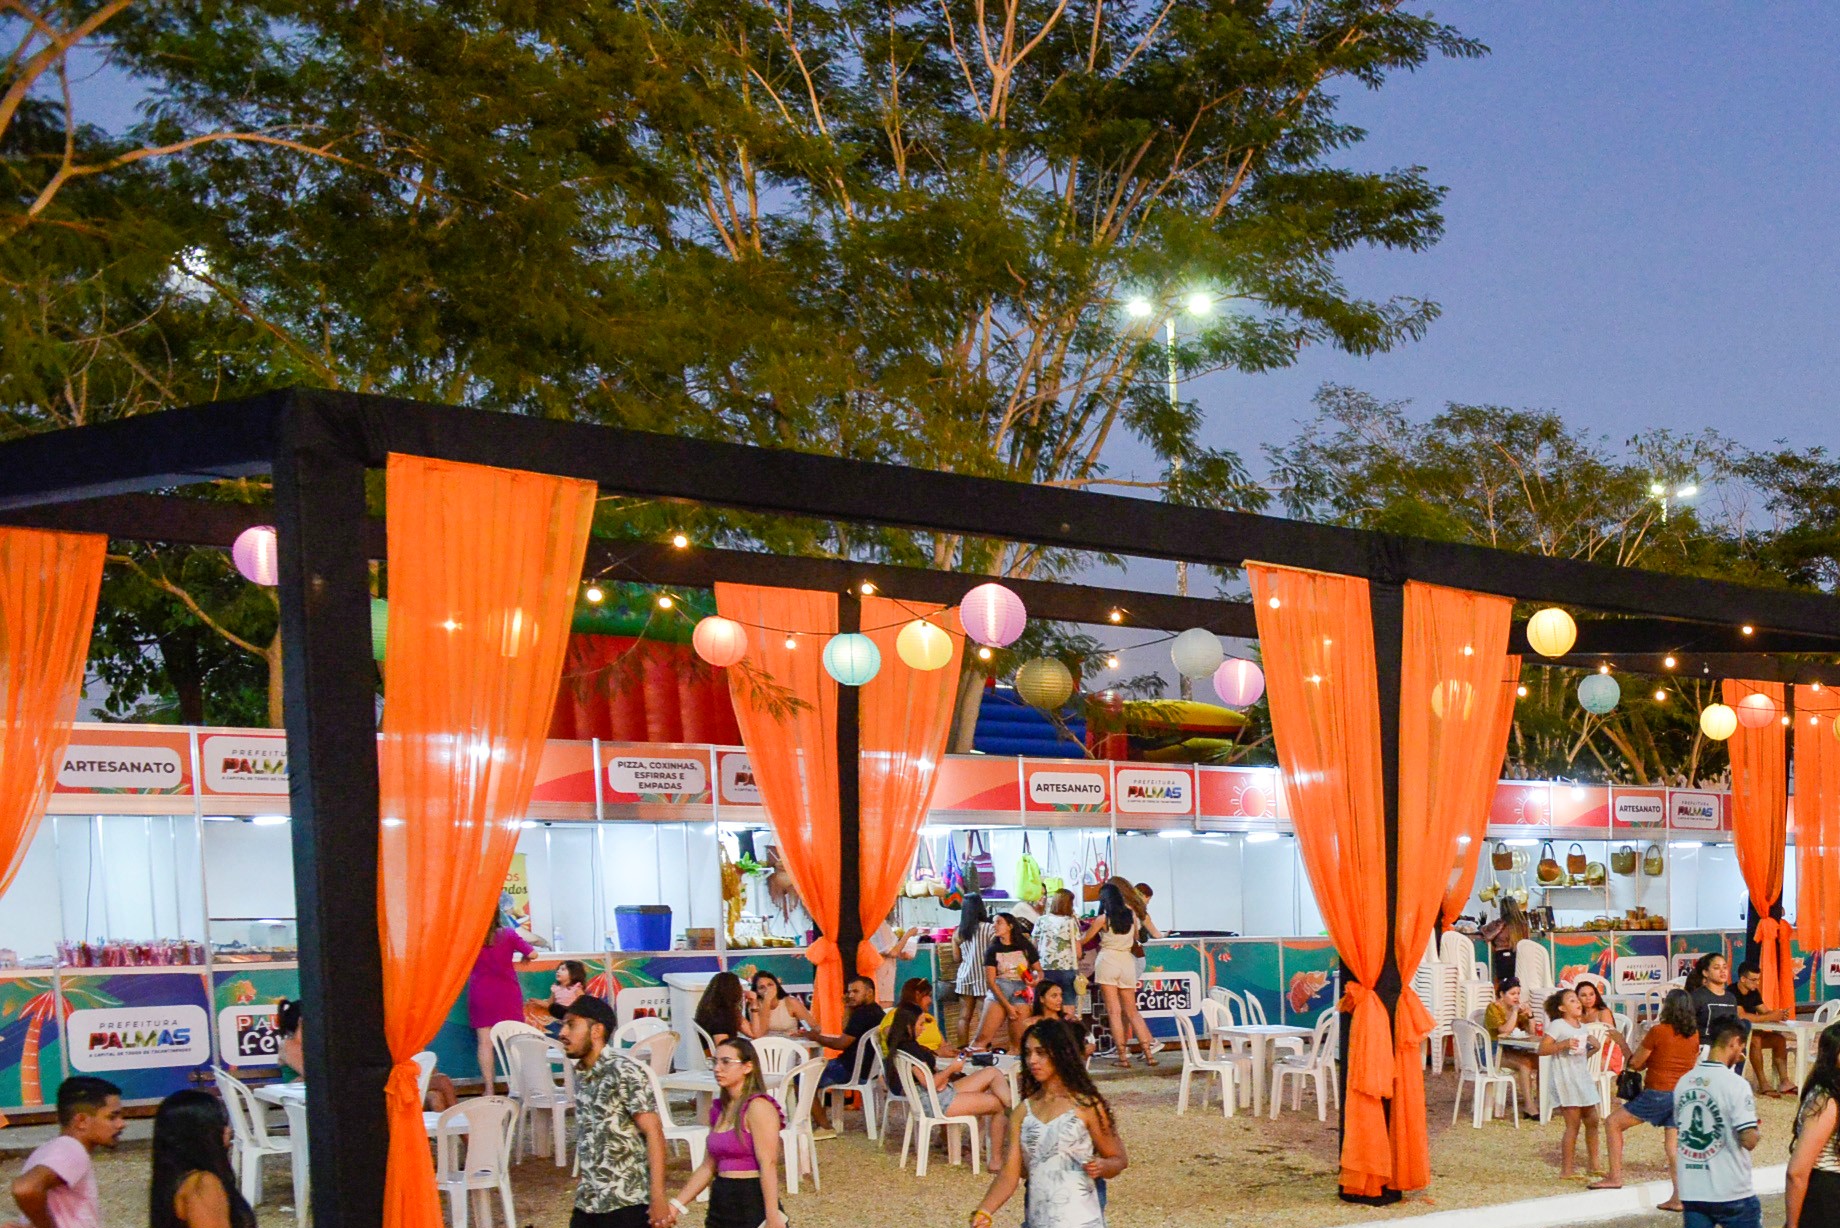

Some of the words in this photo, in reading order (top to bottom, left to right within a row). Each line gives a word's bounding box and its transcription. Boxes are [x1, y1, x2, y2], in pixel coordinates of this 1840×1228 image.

[232, 749, 287, 757] PREFEITU
[63, 760, 175, 774] ARTESANATO
[221, 757, 288, 774] PALM
[617, 761, 647, 770] PIZZA,
[649, 761, 698, 771] COXINHAS,
[634, 771, 677, 780] ESFIRRAS
[679, 772, 685, 780] E
[638, 781, 682, 790] EMPADAS
[1035, 783, 1102, 794] ARTESANATO
[1127, 785, 1182, 799] PALMAS
[1619, 805, 1661, 813] ARTESANATO
[1677, 805, 1713, 817] PALMAS
[1622, 969, 1661, 981] PALMAS
[1135, 979, 1190, 993] PALMAS
[1136, 991, 1187, 1009] férias
[633, 1006, 671, 1021] PAL
[99, 1019, 178, 1029] PREFEITURA
[88, 1028, 191, 1050] PALMAS
